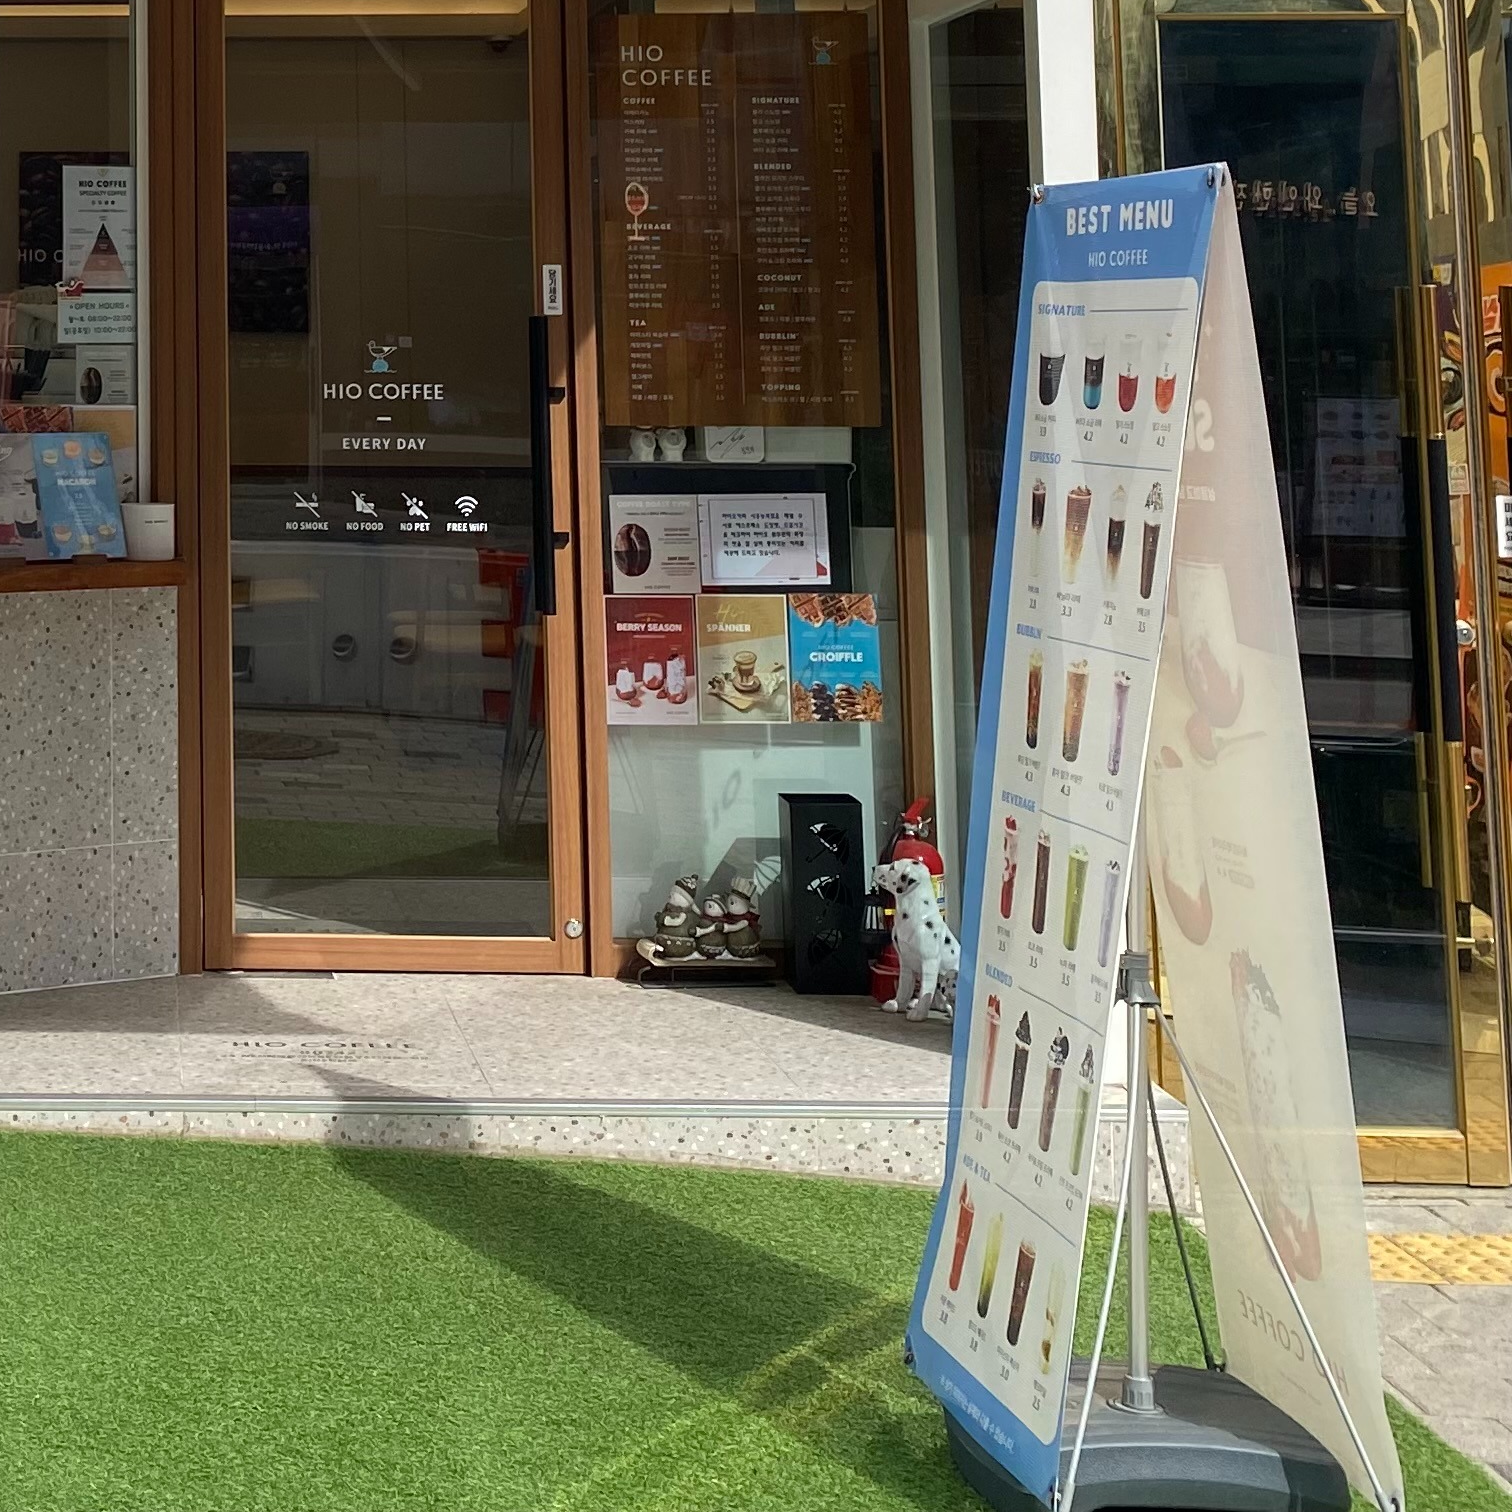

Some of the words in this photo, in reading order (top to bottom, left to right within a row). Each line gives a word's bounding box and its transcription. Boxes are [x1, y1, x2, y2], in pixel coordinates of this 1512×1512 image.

[621, 45, 664, 62] HIO
[622, 69, 712, 87] COFFEE
[751, 96, 800, 105] SIGNATURE
[1065, 204, 1112, 236] BEST
[1119, 198, 1174, 232] MENU
[1088, 252, 1106, 268] HIO
[1109, 248, 1148, 267] COFFEE
[1037, 303, 1086, 316] SIGNATURE
[323, 382, 363, 400] HIO
[368, 382, 444, 400] COFFEE
[342, 437, 391, 451] EVERY
[396, 437, 427, 451] DAY
[285, 522, 299, 531] NO
[299, 521, 329, 531] SMOKE
[346, 522, 360, 531] NO
[360, 521, 384, 531] FOOD
[400, 522, 413, 531] NO
[414, 522, 431, 531] PET
[446, 522, 468, 532] FREE
[616, 622, 646, 632] BERRY
[647, 622, 683, 632] SEASON
[809, 651, 863, 662] CROIFFLE
[1001, 790, 1037, 814] BEVERAGE
